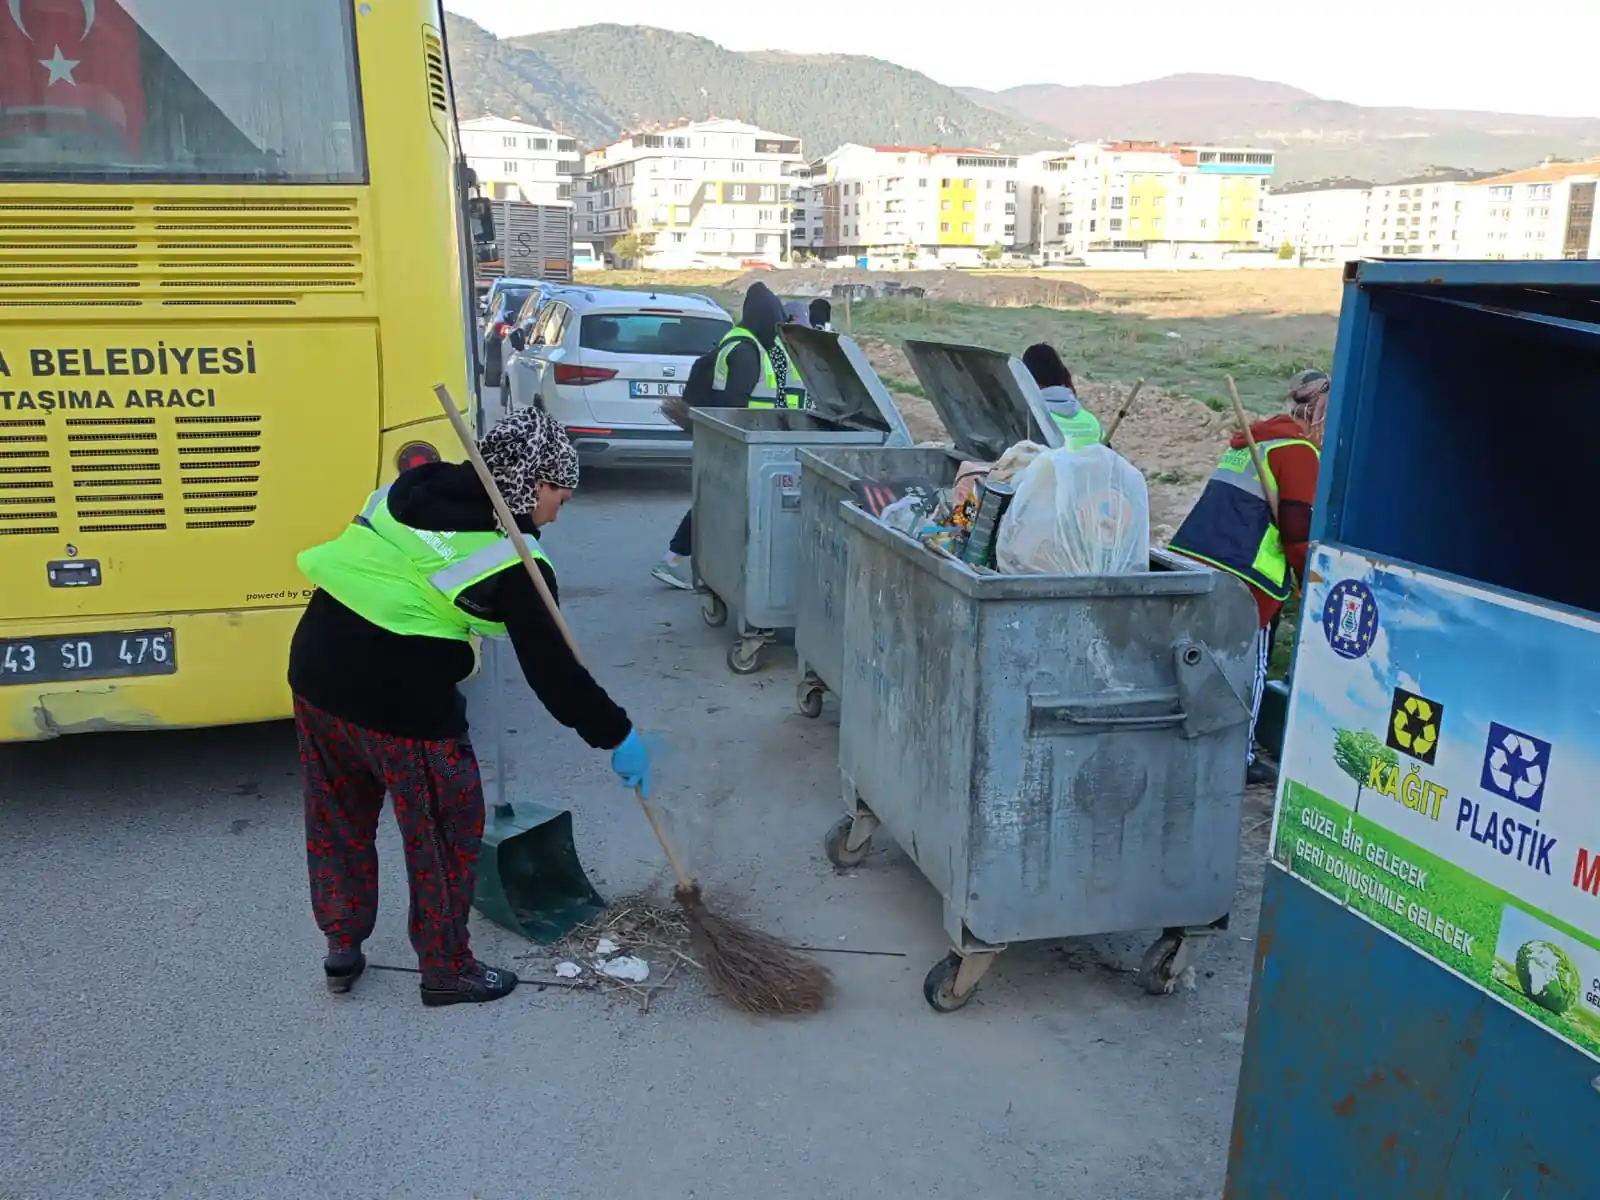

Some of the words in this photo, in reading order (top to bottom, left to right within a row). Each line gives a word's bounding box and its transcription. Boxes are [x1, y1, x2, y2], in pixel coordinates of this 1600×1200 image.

[30, 340, 256, 376] BELEDİYESİ
[0, 388, 114, 415] TAŞIMA
[125, 388, 215, 408] ARACI
[246, 589, 285, 602] powered
[287, 589, 298, 599] by
[4, 644, 36, 672] 43
[60, 641, 93, 669] SD
[119, 636, 167, 665] 476
[1368, 755, 1449, 821] KAĞIT
[1301, 806, 1339, 843] GÜZEL
[1341, 827, 1364, 855] BİR
[1366, 842, 1429, 891] GELECEK
[1456, 796, 1557, 876] PLASTİK
[1296, 838, 1326, 868] GERİ
[1325, 854, 1405, 916] DÖNÜŞÜMLE
[1407, 902, 1475, 957] GELECEK
